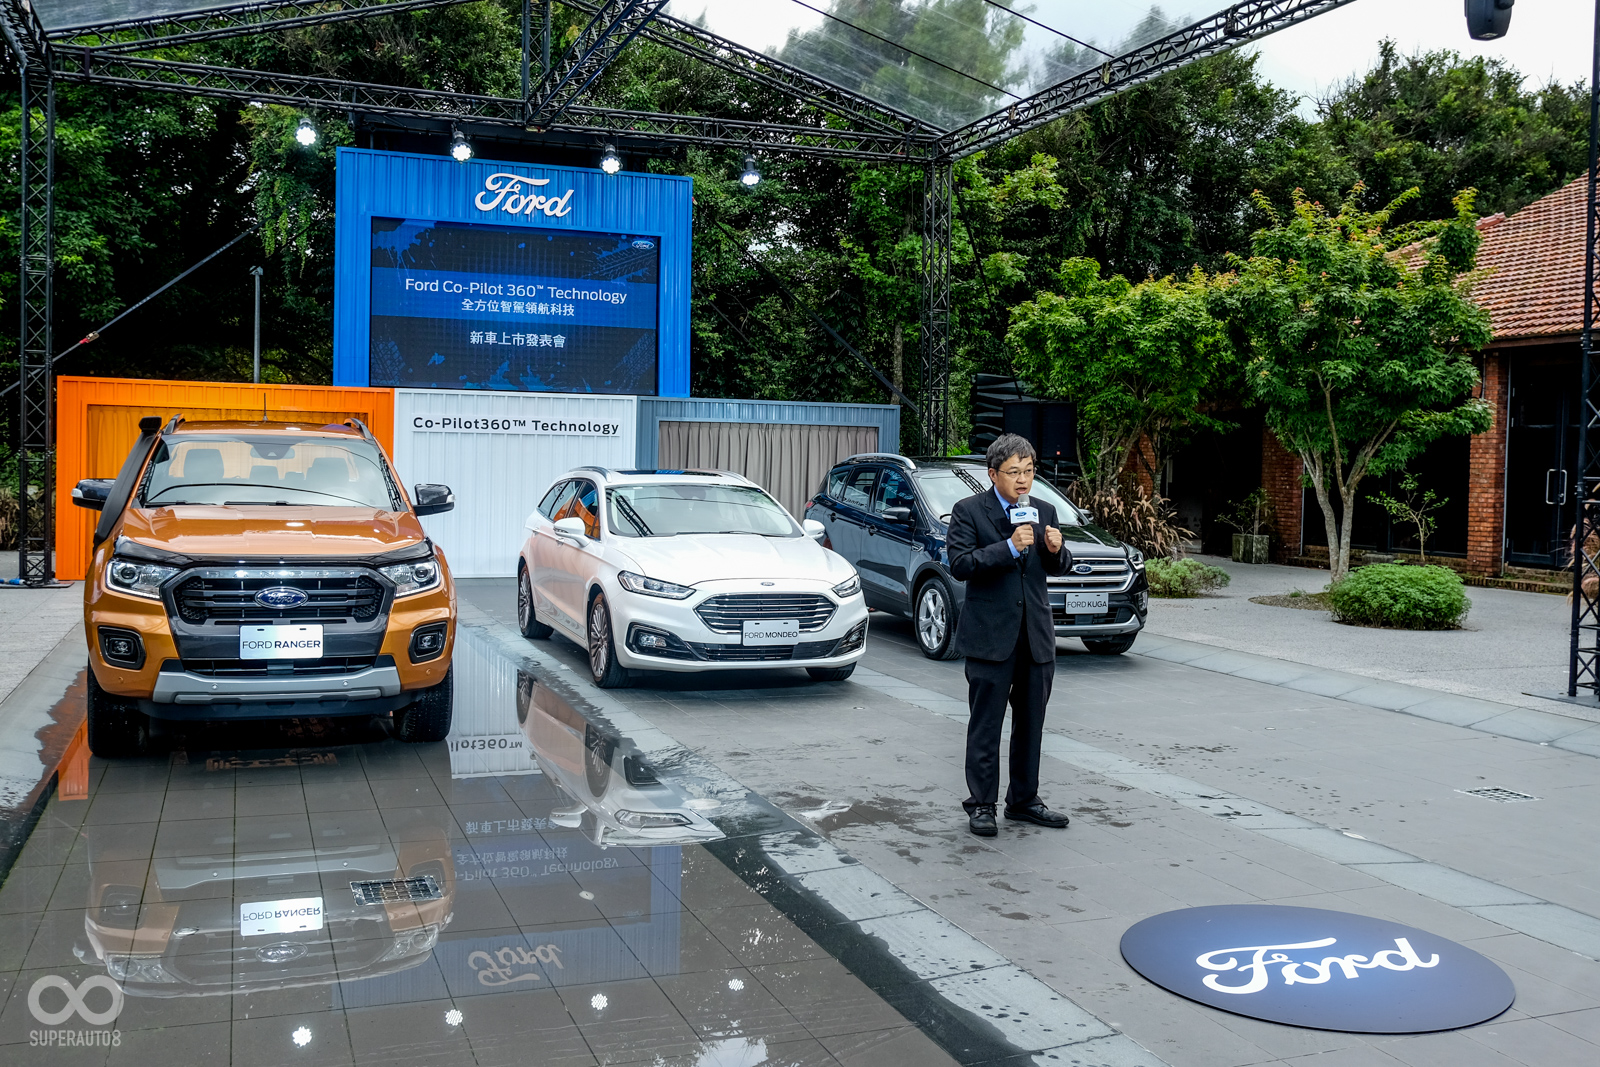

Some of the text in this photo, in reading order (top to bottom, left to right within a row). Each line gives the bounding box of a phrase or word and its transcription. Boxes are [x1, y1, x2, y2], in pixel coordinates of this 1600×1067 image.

[475, 172, 574, 217] Ford
[405, 278, 438, 292] Ford
[443, 280, 503, 296] Co-Pilot
[547, 286, 627, 304] Technology
[462, 299, 575, 316] 全方位智駕領航科技
[470, 330, 566, 348] 新車上市發表會
[532, 419, 619, 435] Technology
[1087, 600, 1108, 608] KUGA
[243, 639, 320, 650] FORD RANGER
[1195, 937, 1440, 995] Ford
